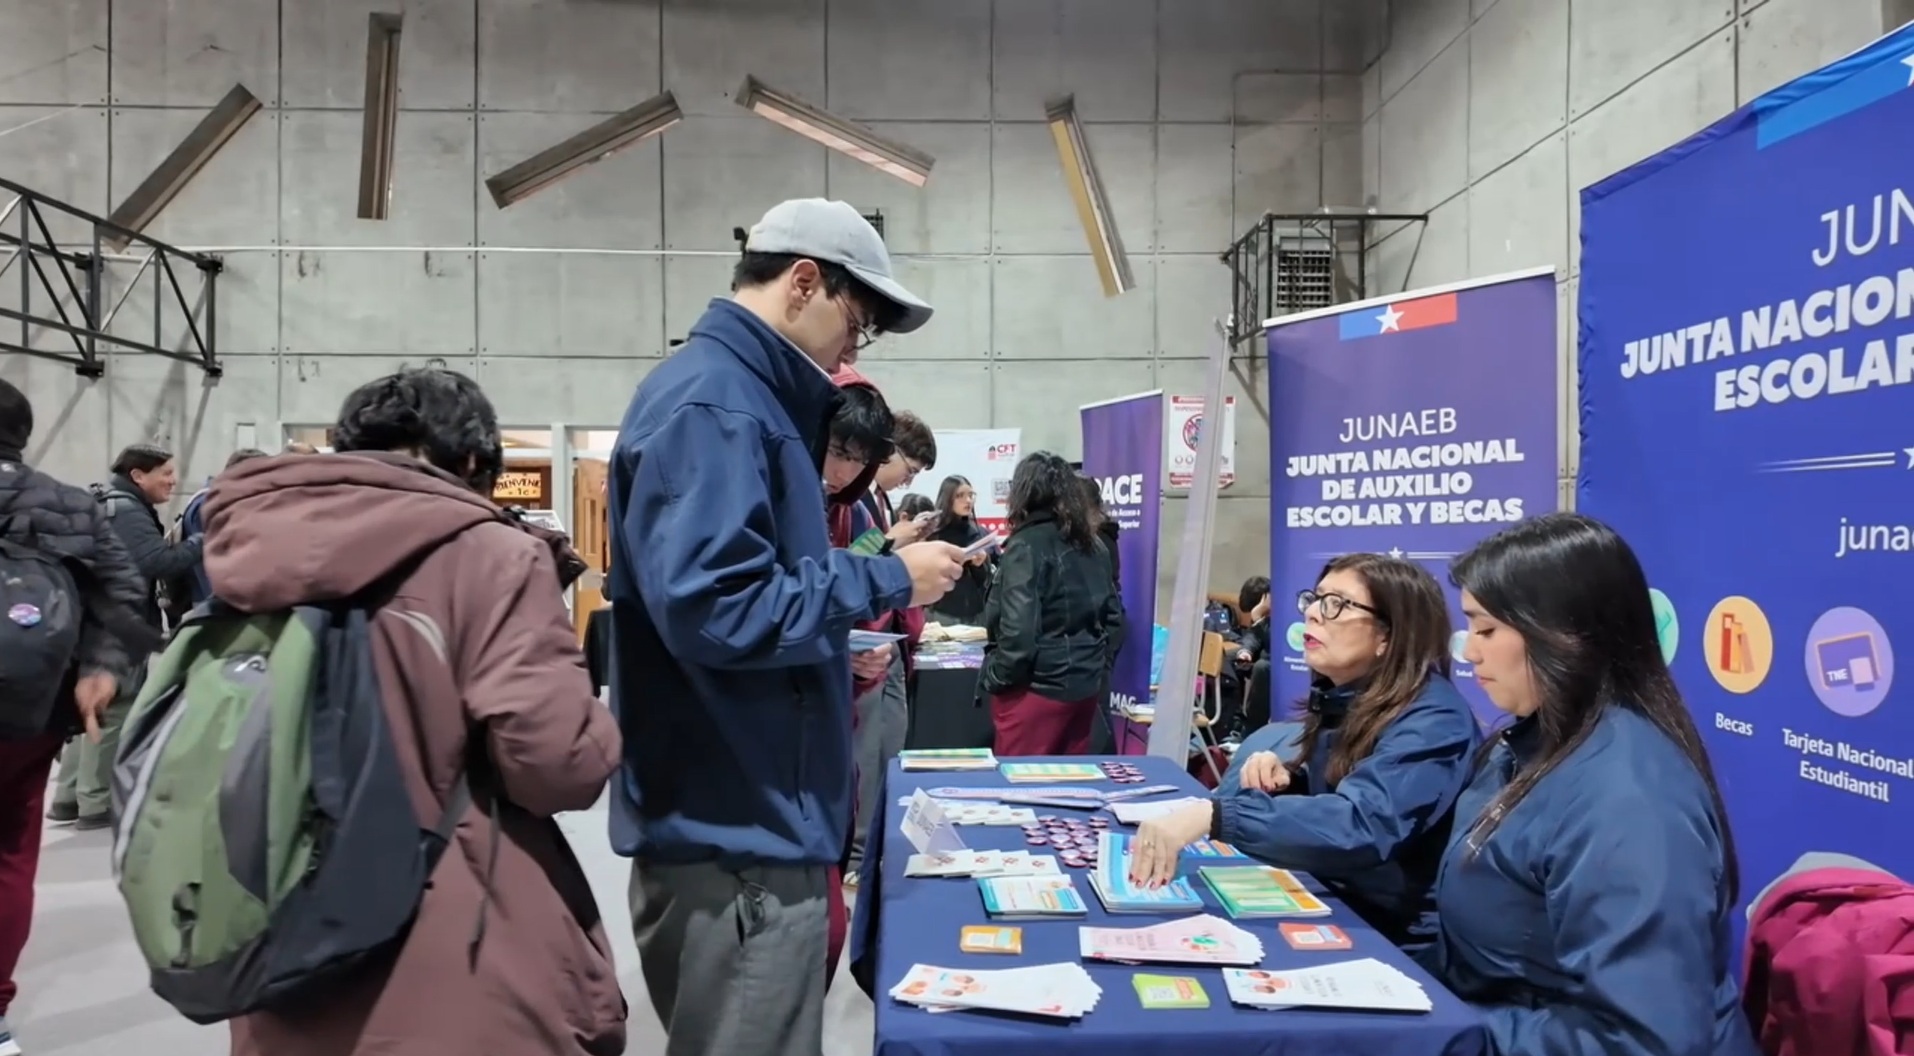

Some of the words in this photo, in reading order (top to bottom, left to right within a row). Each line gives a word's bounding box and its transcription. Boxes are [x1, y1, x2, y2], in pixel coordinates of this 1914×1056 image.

[1619, 316, 1734, 379] JUNTA
[1339, 407, 1457, 443] JUNAEB
[1286, 451, 1370, 477] JUNTA
[1372, 438, 1525, 471] NACIONAL
[1094, 473, 1143, 505] ACE
[1321, 478, 1356, 500] DE
[1358, 471, 1473, 499] AUXILIO
[1286, 503, 1402, 528] ESCOLAR
[1405, 502, 1427, 524] Y
[1430, 498, 1524, 523] BECAS
[1834, 517, 1914, 558] juna
[1827, 668, 1848, 682] TNE
[1715, 712, 1754, 737] Becas
[1782, 728, 1834, 757] Tarjeta
[1837, 741, 1914, 779] Nacional
[1800, 760, 1890, 803] Estudiantil
